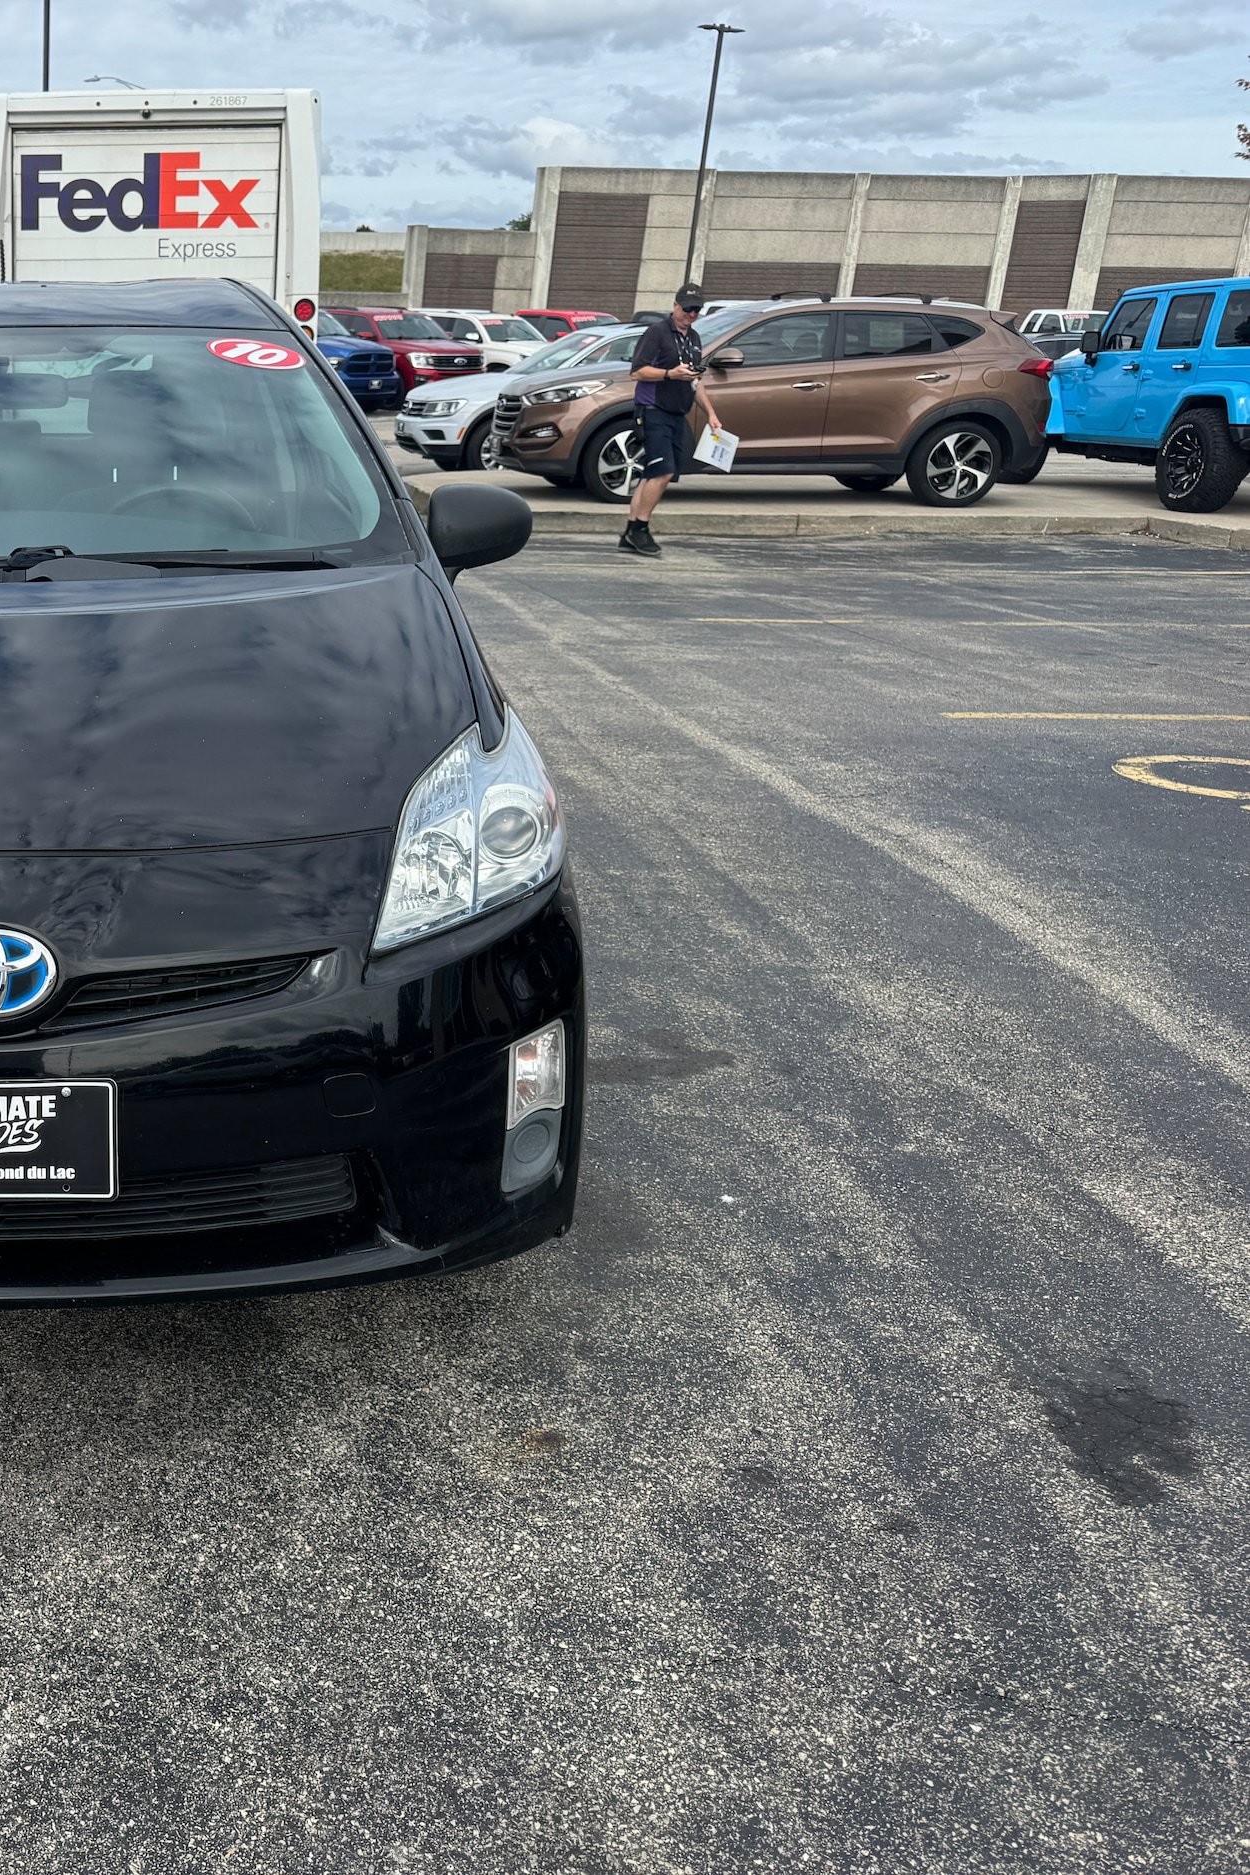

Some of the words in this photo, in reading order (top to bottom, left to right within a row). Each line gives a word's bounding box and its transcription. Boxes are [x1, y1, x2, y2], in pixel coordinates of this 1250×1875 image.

[209, 95, 248, 106] 261867
[20, 151, 261, 233] FedEx
[158, 238, 237, 262] Express
[221, 343, 289, 365] 10
[27, 1166, 47, 1180] du
[50, 1166, 76, 1180] Lac
